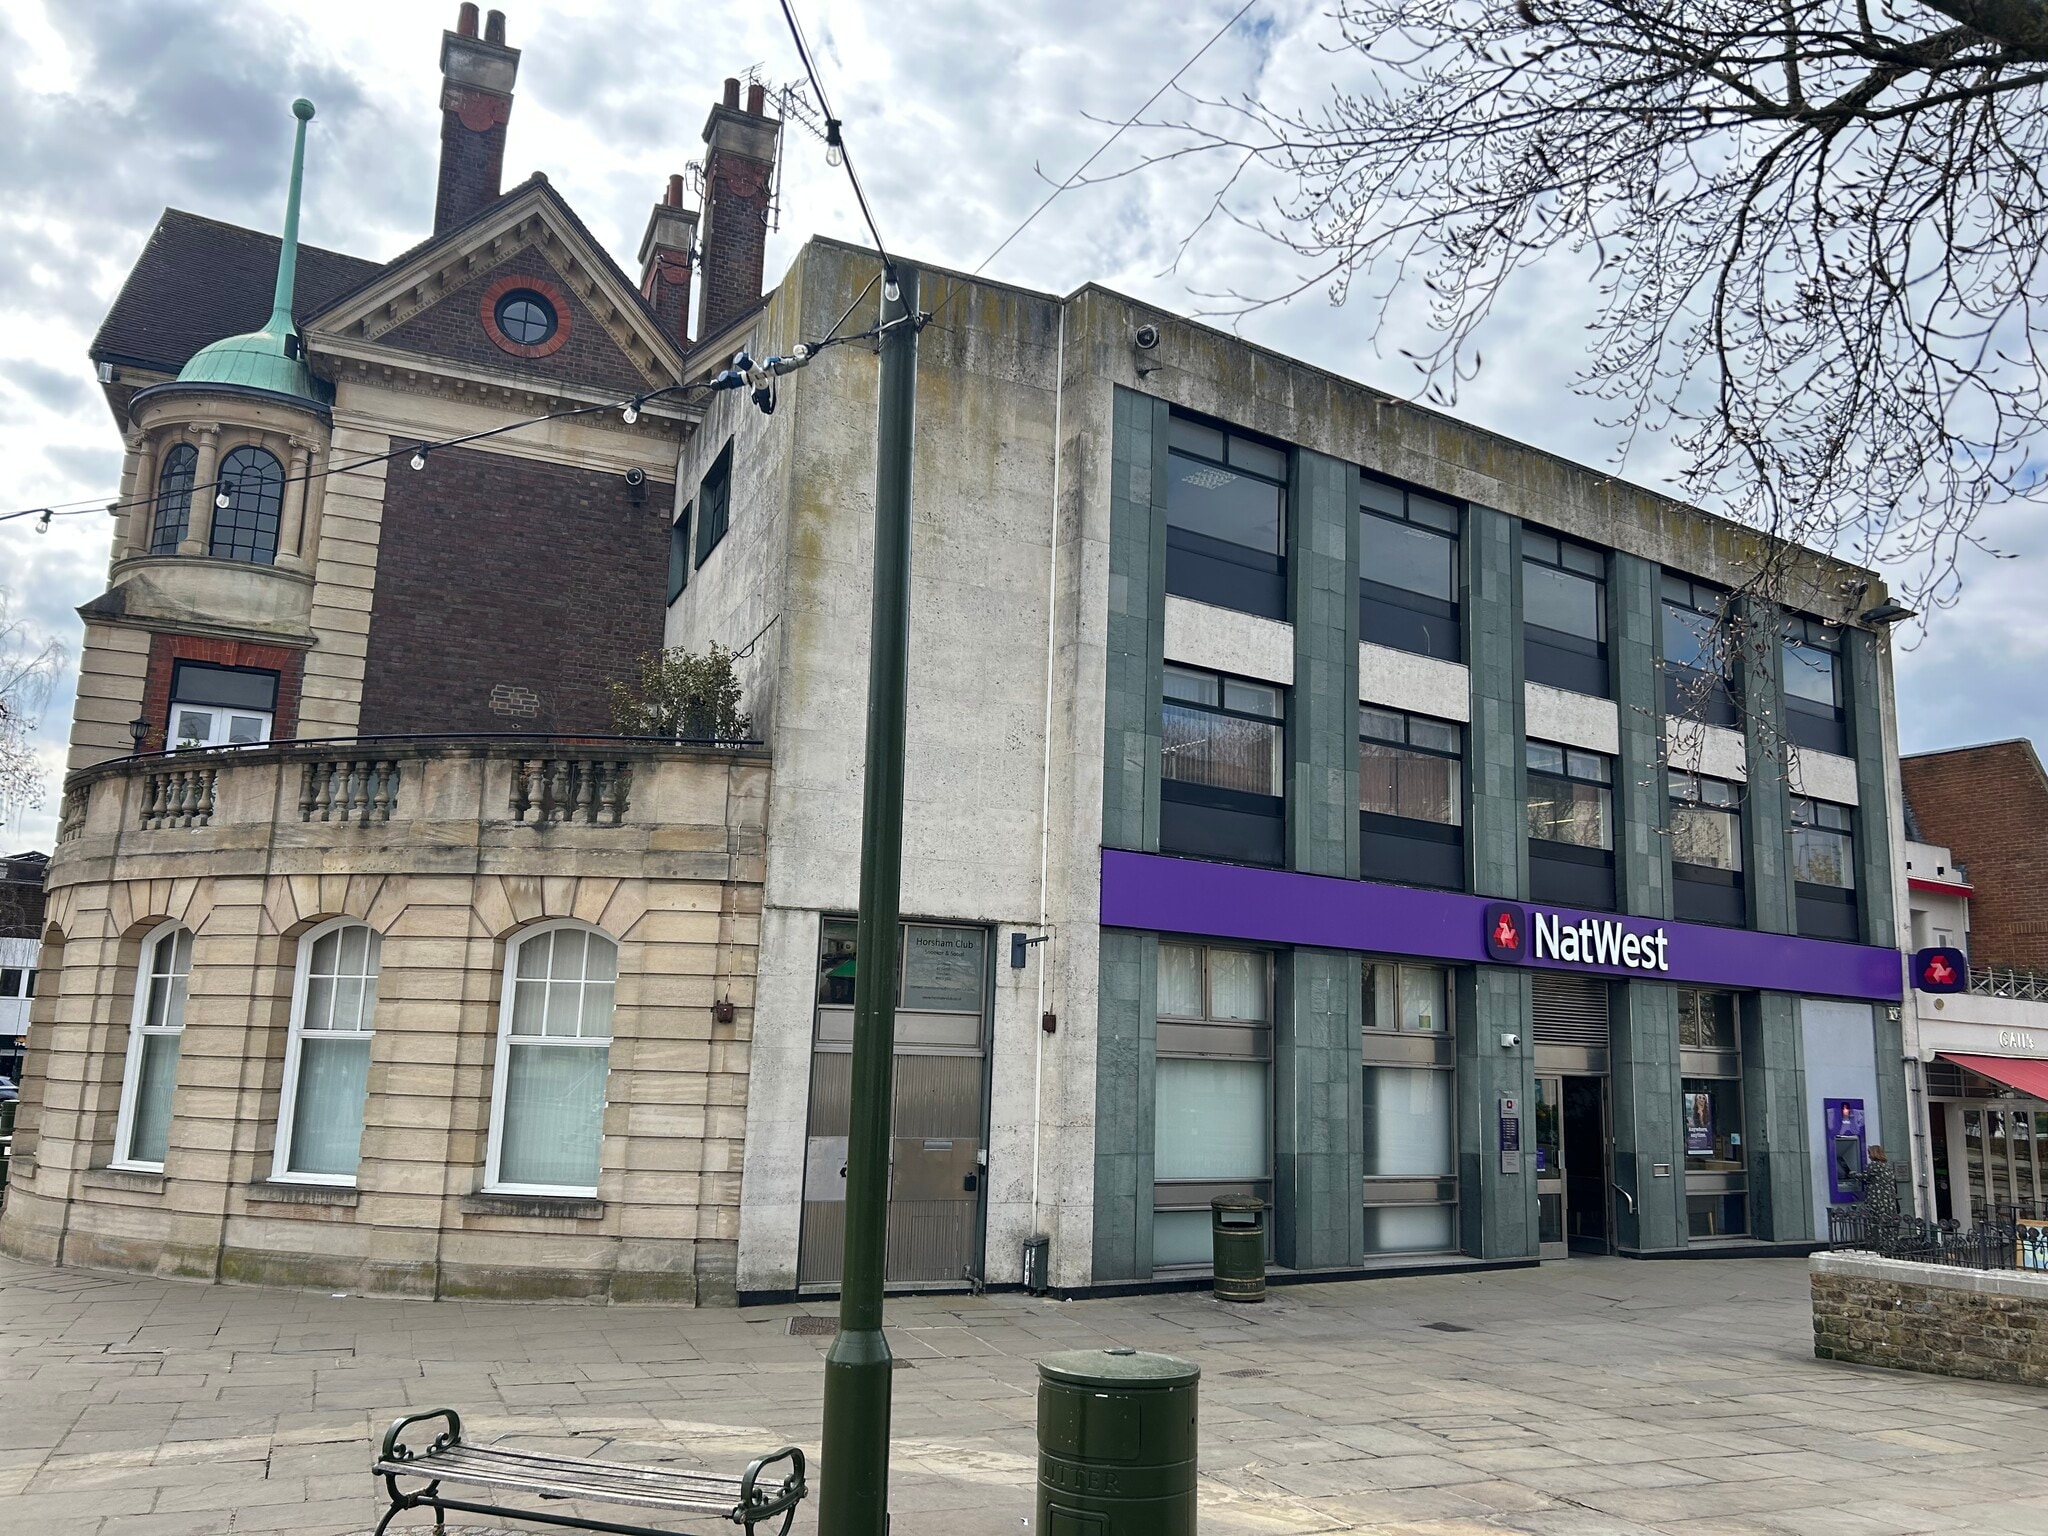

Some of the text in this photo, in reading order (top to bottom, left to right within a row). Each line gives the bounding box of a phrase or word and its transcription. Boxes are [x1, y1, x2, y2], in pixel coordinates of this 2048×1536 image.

[916, 937, 974, 949] Horsham Club
[1534, 912, 1669, 971] NatWest
[1043, 1461, 1121, 1493] LITTER
